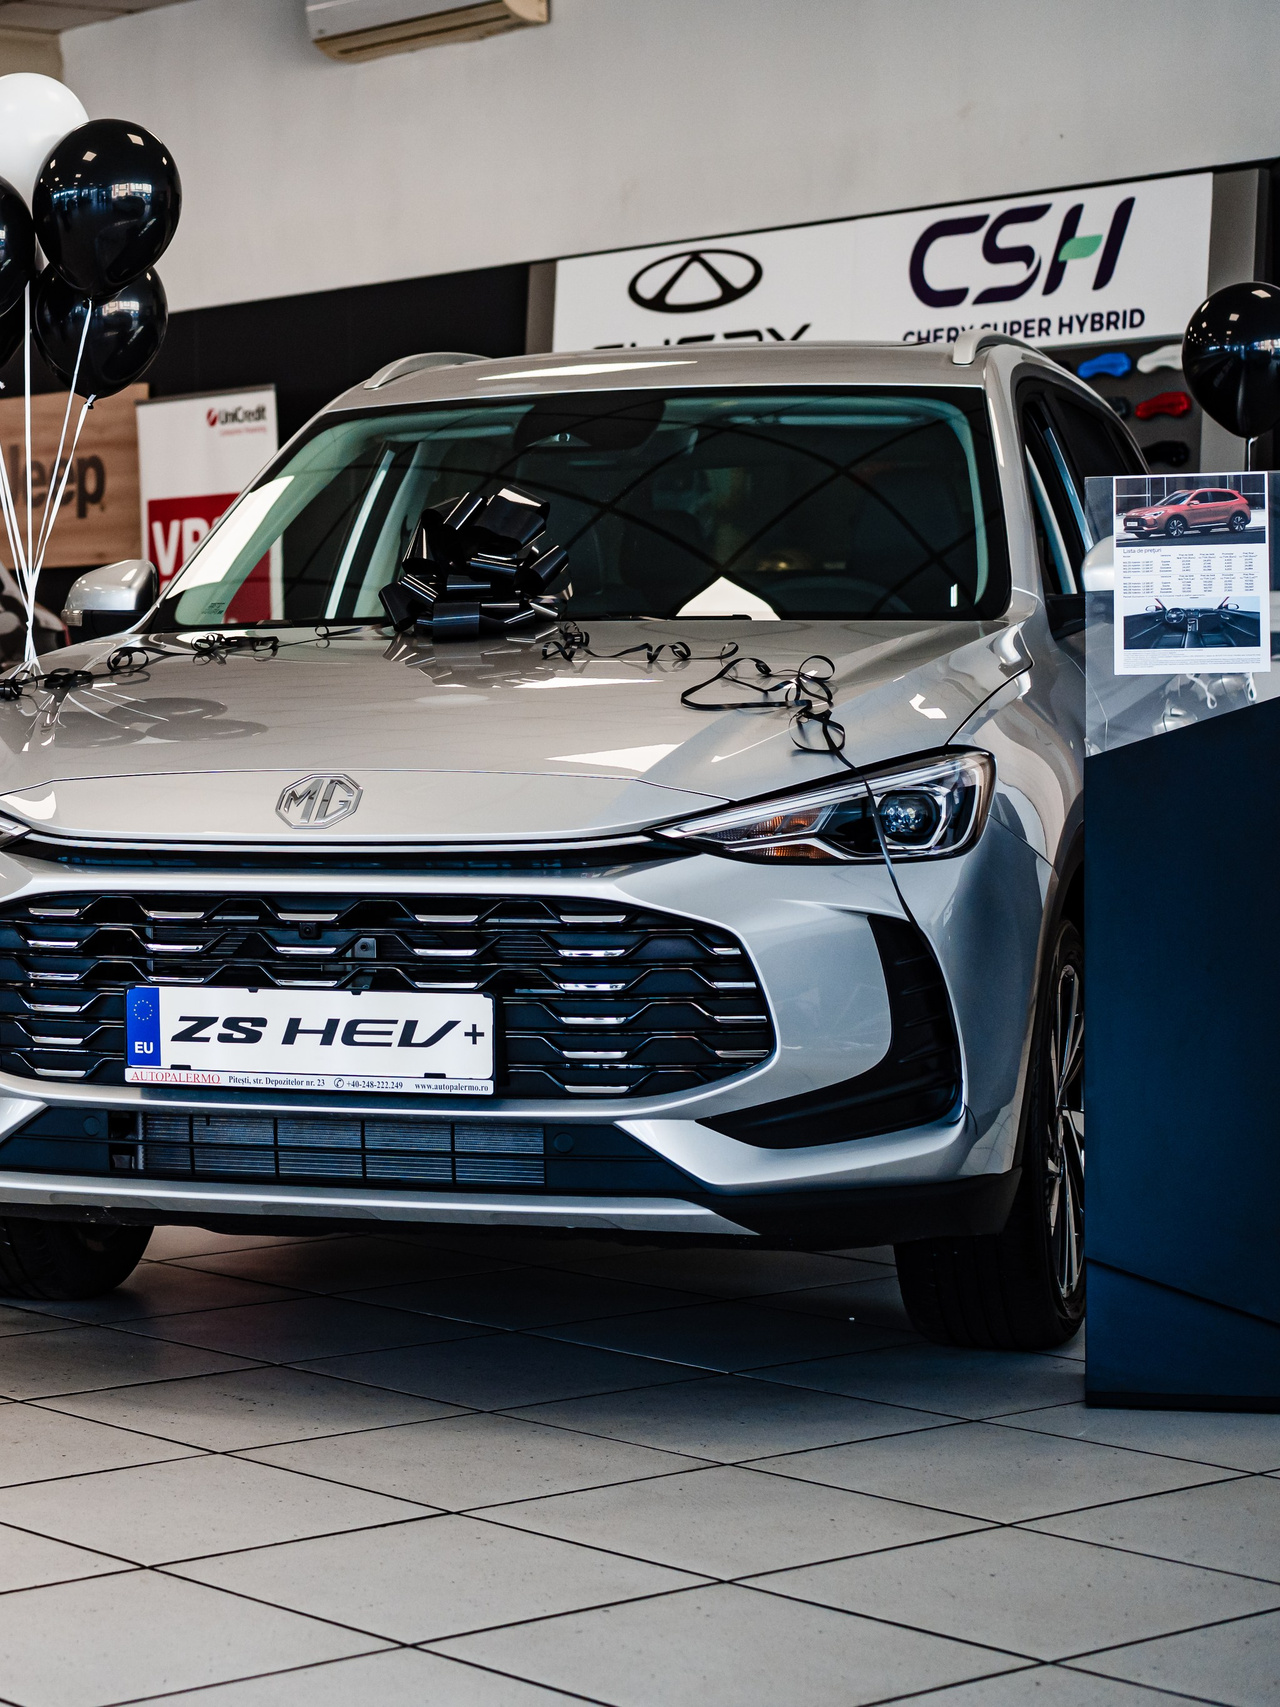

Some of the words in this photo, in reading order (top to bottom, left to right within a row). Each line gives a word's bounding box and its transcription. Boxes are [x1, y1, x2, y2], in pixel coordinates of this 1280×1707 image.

[909, 197, 1136, 308] CSH
[1058, 308, 1146, 335] HYBRID
[282, 777, 356, 824] MG
[170, 1016, 268, 1044] ZS
[134, 1041, 154, 1054] EU
[130, 1071, 221, 1084] AUTOPALERMO
[252, 1077, 264, 1085] str.
[265, 1077, 305, 1087] Depozitelor
[305, 1079, 316, 1087] nr.
[317, 1079, 326, 1087] 23
[414, 1083, 489, 1093] www.autopalermo.ro
